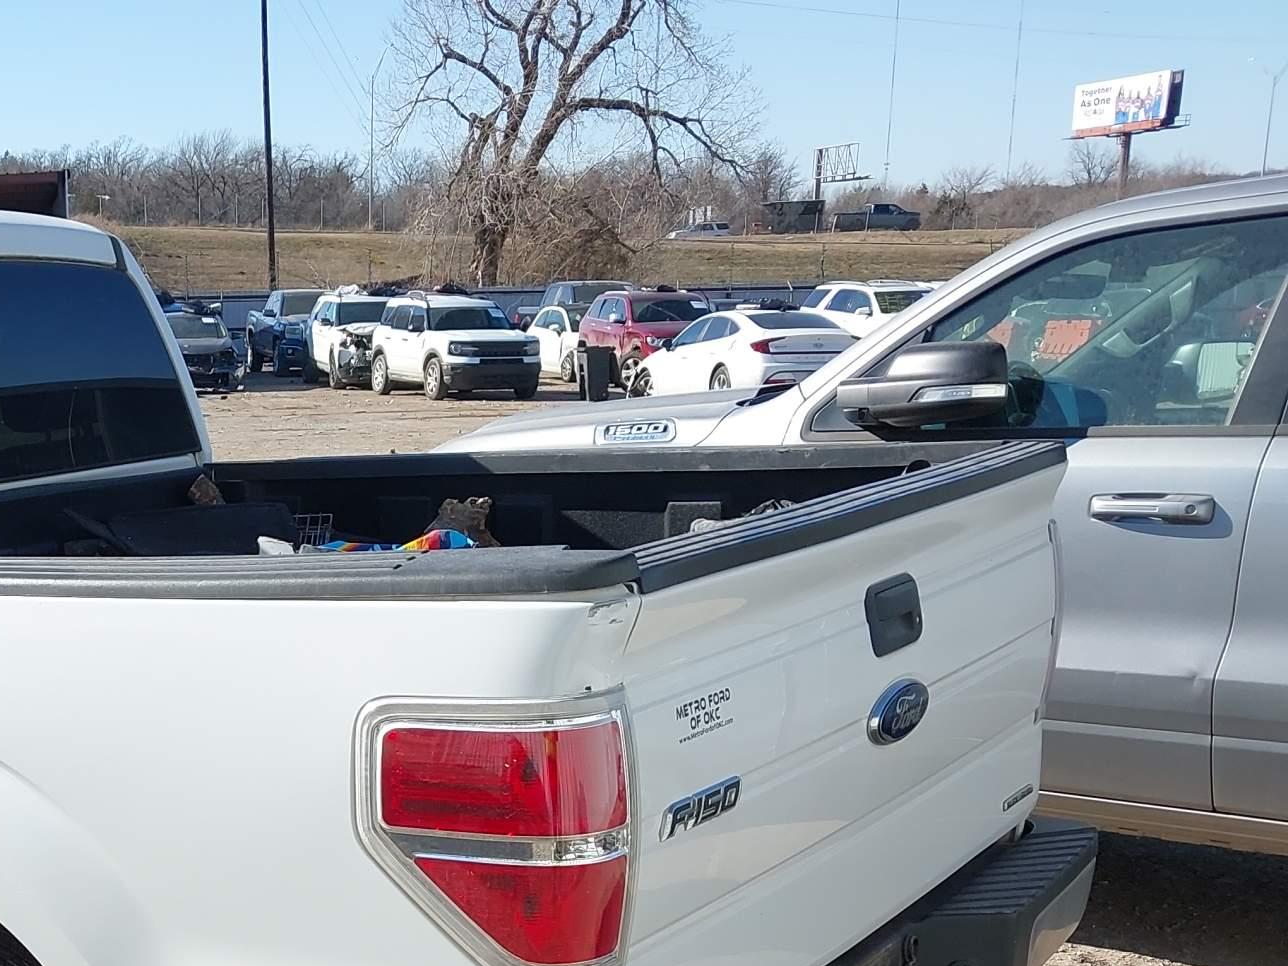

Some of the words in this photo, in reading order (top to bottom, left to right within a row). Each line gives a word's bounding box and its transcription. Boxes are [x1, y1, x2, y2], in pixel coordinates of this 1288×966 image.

[1081, 87, 1113, 97] Together
[1080, 99, 1092, 108] As
[1093, 97, 1111, 107] One
[606, 422, 668, 436] 1500
[675, 697, 707, 721] METRO
[708, 687, 731, 708] FORD
[690, 713, 702, 731] OF
[703, 706, 721, 725] OKC
